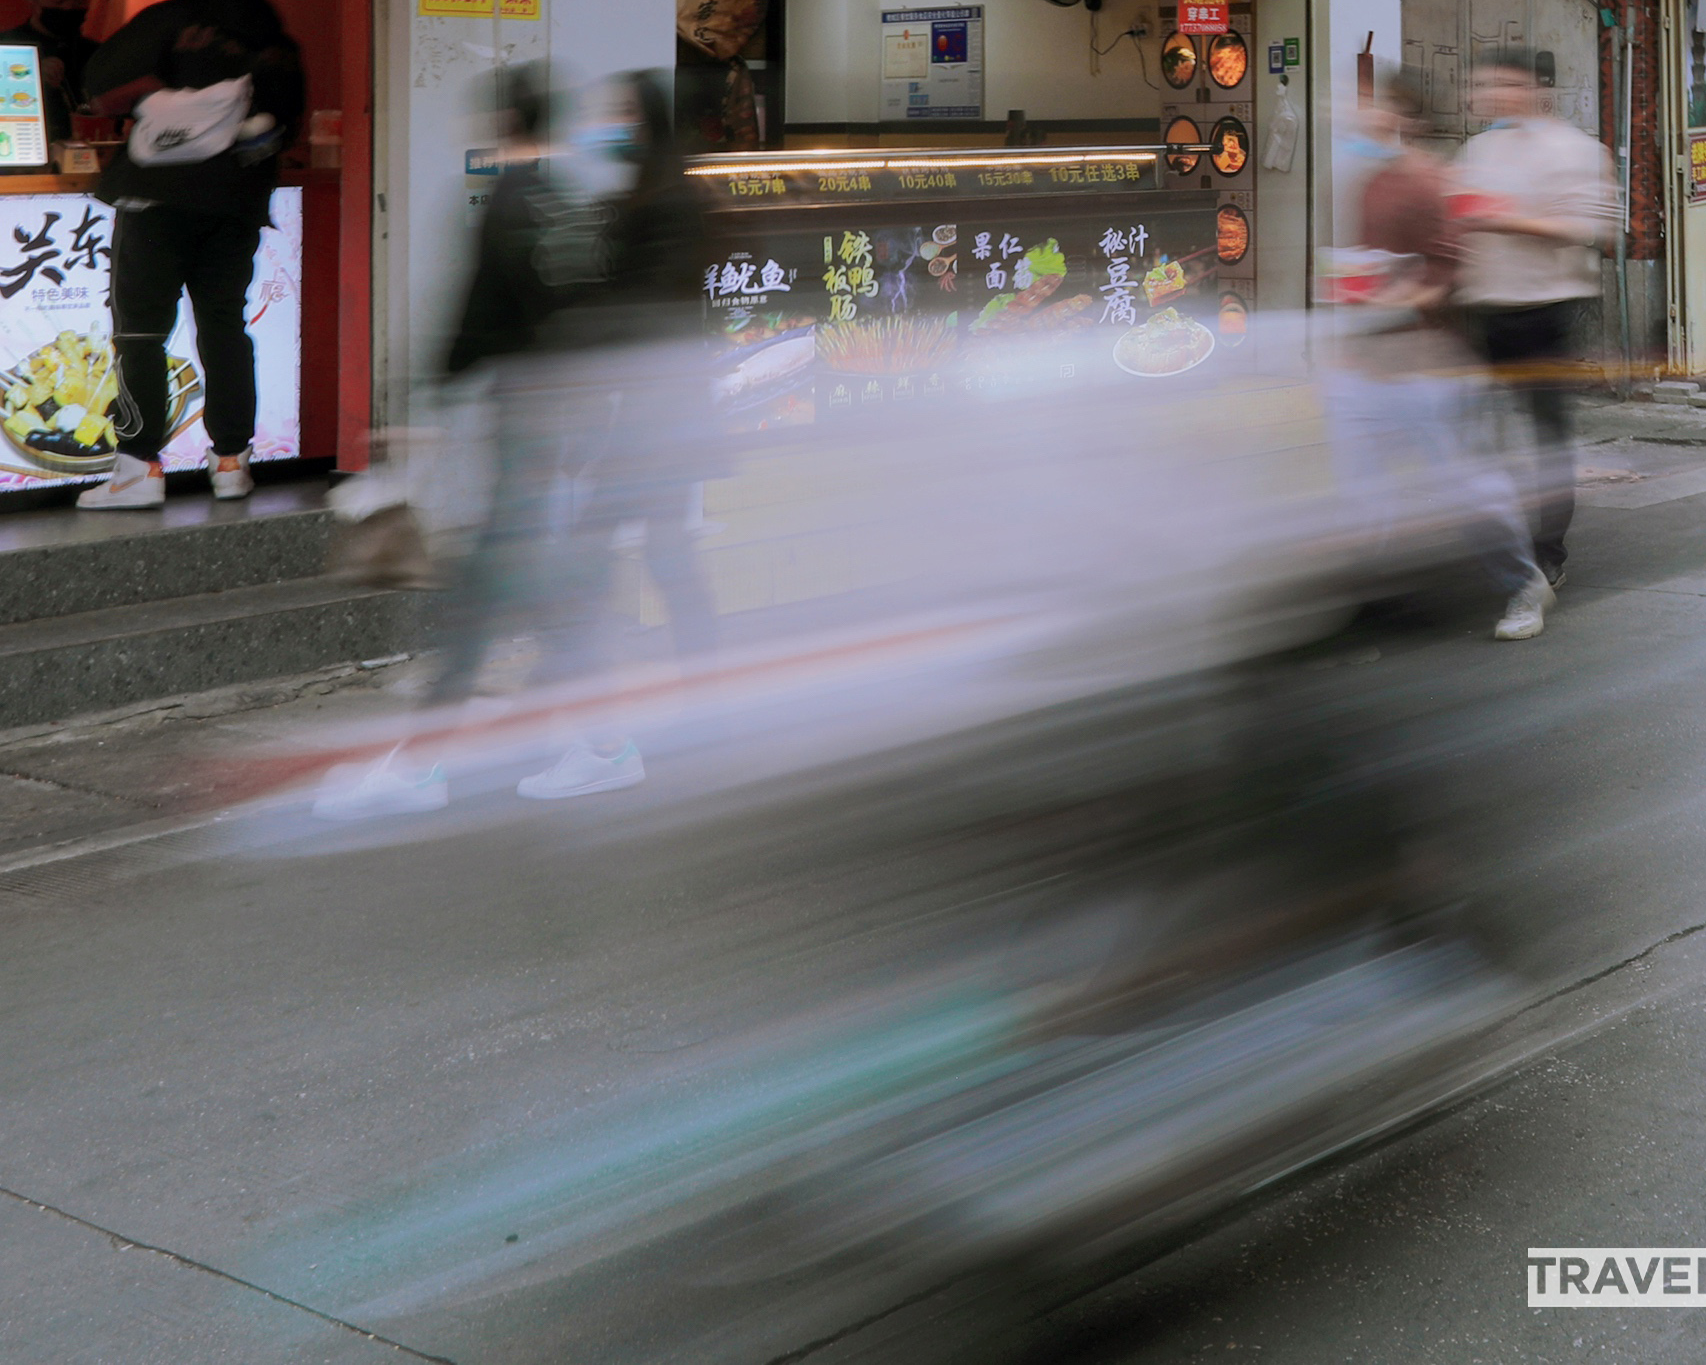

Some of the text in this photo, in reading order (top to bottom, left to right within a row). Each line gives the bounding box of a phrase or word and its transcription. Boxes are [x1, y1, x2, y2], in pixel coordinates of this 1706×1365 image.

[1187, 6, 1220, 21] 穿串工
[838, 230, 873, 267] 铁
[972, 232, 1023, 260] 果仁
[1099, 224, 1149, 258] 秘汁
[822, 264, 879, 298] 板鸭
[985, 257, 1034, 290] 面筋
[32, 286, 90, 303] 特色美味
[828, 294, 858, 323] 肠
